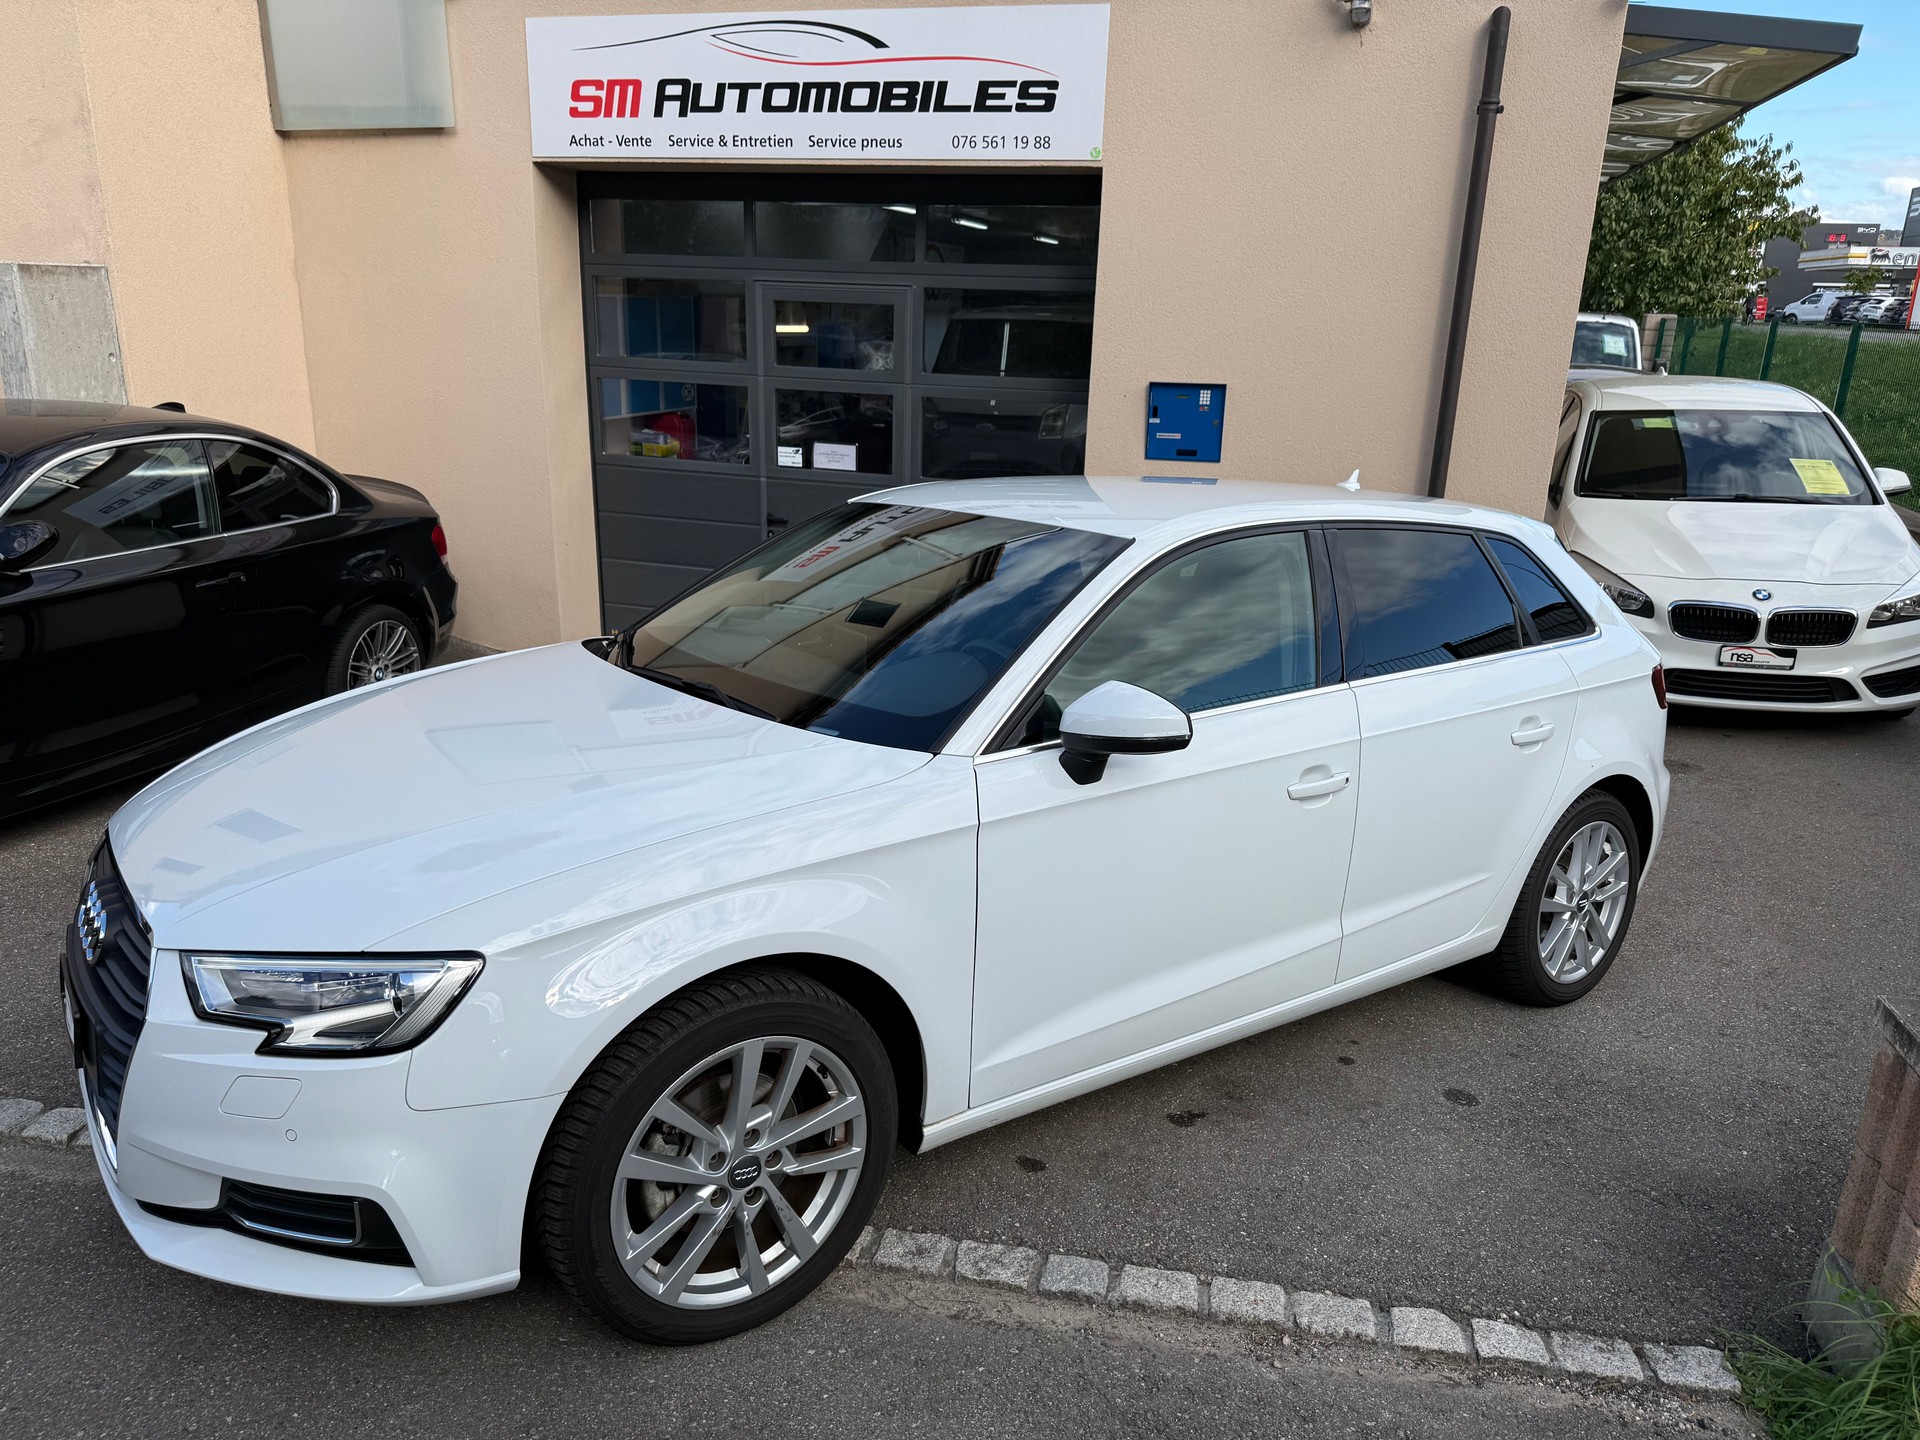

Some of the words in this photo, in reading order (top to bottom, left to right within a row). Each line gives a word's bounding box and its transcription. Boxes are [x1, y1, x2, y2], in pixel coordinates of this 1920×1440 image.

[568, 78, 643, 119] SM
[569, 133, 605, 148] Achat
[615, 134, 652, 148] Vente
[668, 133, 714, 148] Service
[718, 134, 728, 148] &
[732, 133, 794, 148] Entretien
[808, 134, 857, 149] Service
[861, 137, 903, 152] pneus
[951, 135, 977, 149] 076
[981, 135, 1006, 150] 561
[1013, 135, 1029, 150] 19
[1033, 135, 1051, 150] 88
[1892, 252, 1920, 265] en
[1730, 652, 1754, 663] nsa
